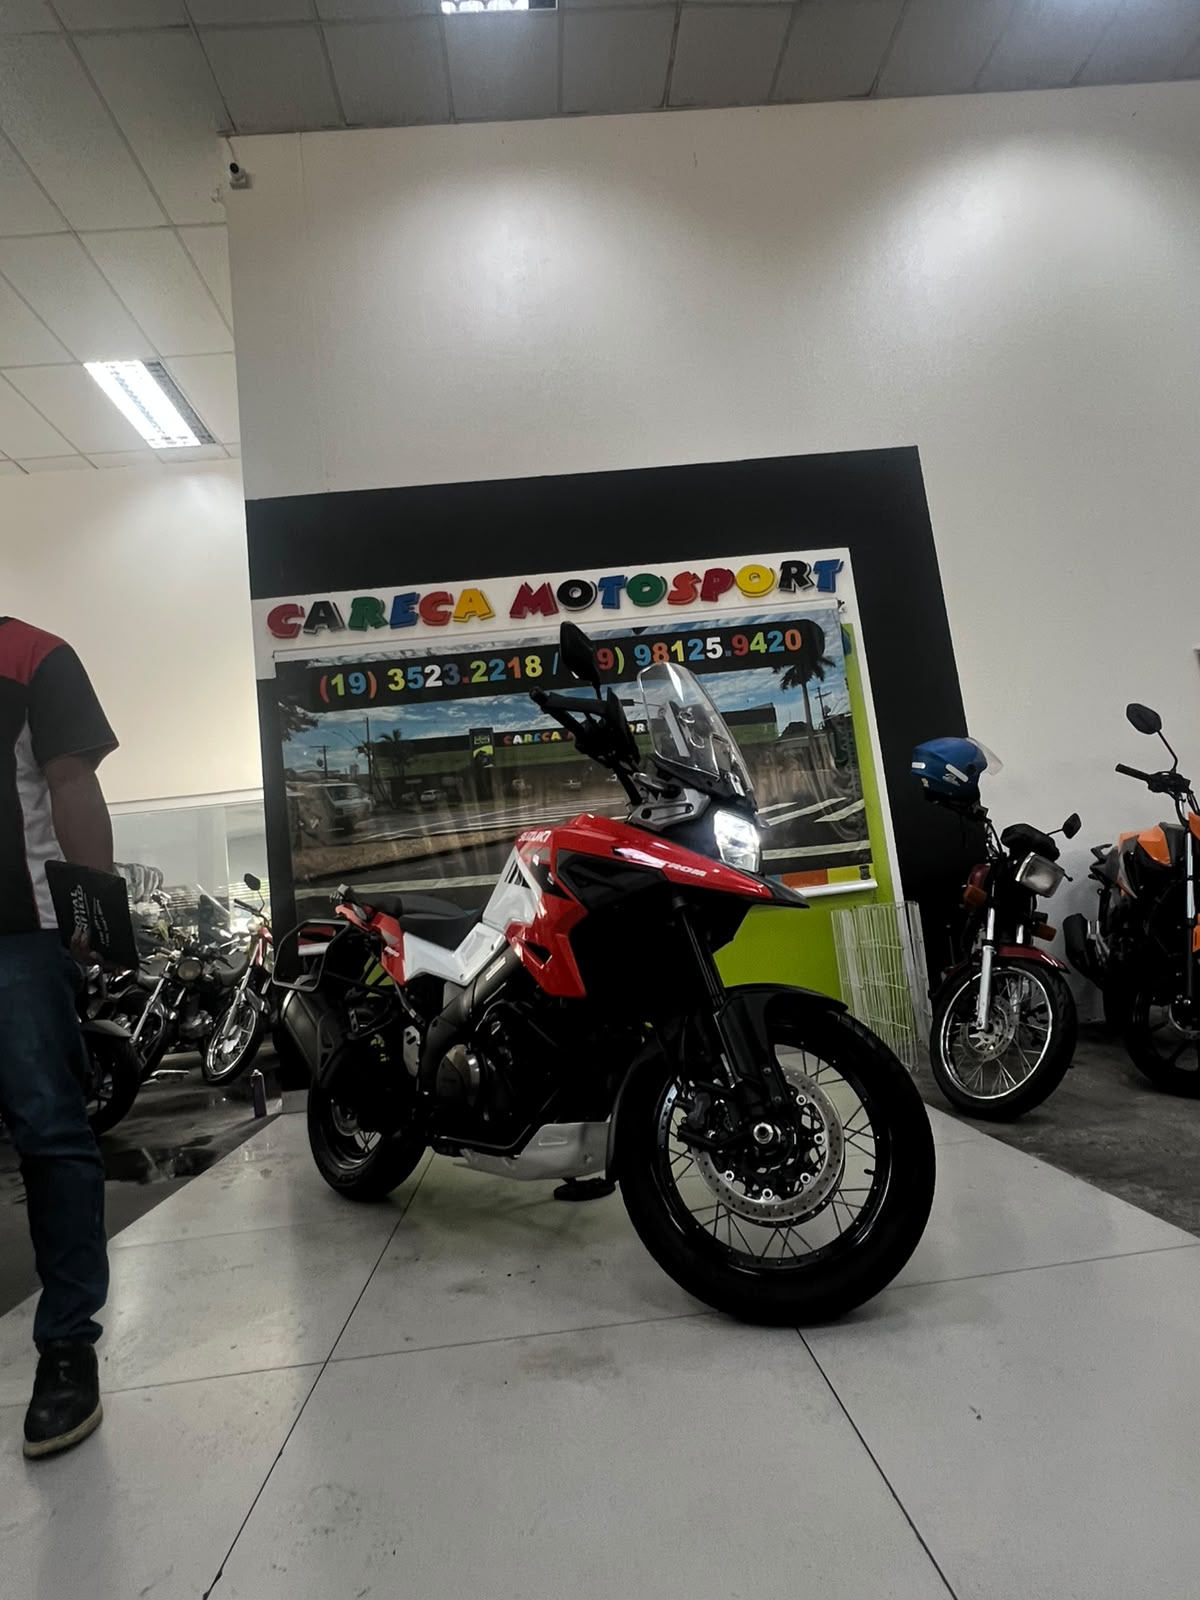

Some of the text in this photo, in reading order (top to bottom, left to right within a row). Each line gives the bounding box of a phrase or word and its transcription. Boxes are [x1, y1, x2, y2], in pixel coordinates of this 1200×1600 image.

[267, 558, 844, 639] CARECA MOTOSPORT
[319, 670, 377, 703] (19)
[386, 654, 543, 691] 3523.2218
[633, 628, 803, 666] 98125.9420
[504, 731, 562, 745] CARECA
